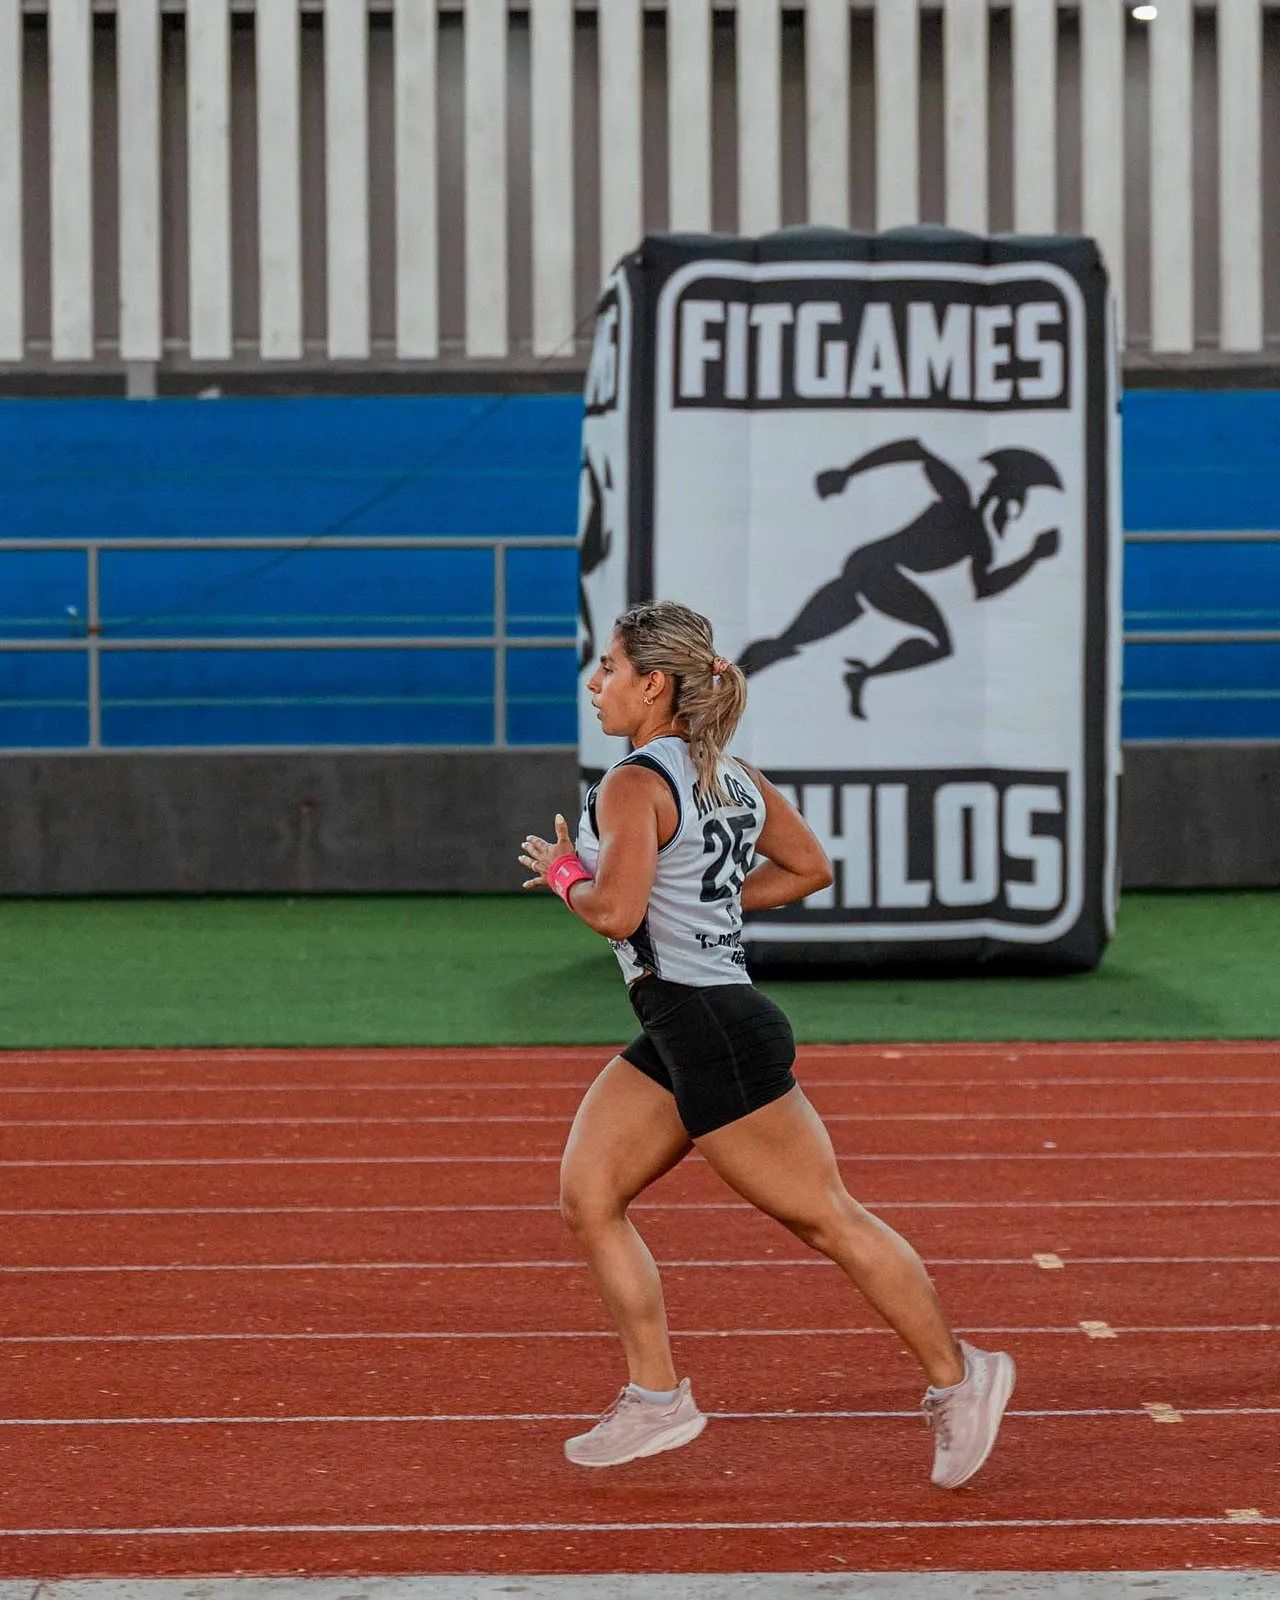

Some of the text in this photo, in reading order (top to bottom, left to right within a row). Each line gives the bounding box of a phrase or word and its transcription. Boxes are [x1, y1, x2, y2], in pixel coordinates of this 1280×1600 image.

[680, 300, 1064, 402] FITGAMES
[700, 812, 757, 903] 25
[778, 782, 1063, 911] HLOS
